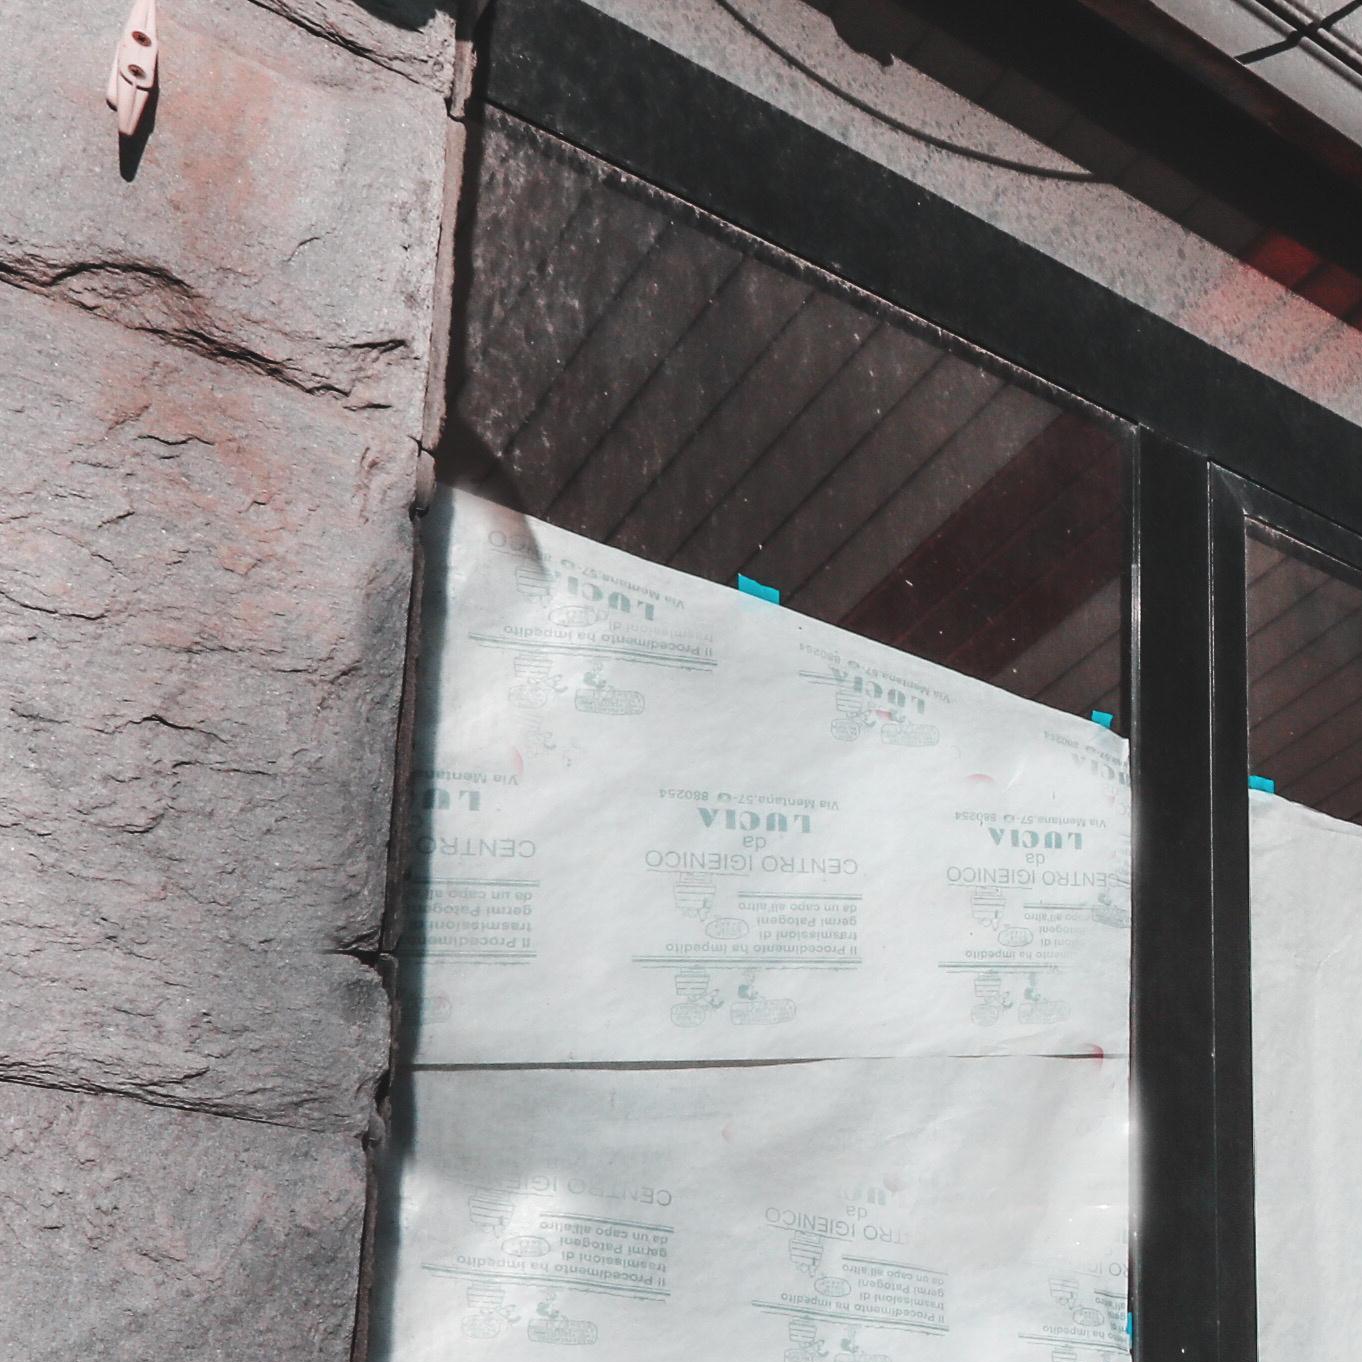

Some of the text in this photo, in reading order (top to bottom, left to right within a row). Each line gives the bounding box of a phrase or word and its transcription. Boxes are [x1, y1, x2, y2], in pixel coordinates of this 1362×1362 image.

[819, 799, 839, 811] Via
[697, 807, 811, 834] LUCIA
[1090, 818, 1106, 828] Via
[742, 836, 766, 852] da
[988, 827, 1082, 850] LUCIA
[645, 850, 858, 875] CENTRO IGIENICO
[1025, 853, 1045, 867] da
[946, 866, 1035, 884] IGIENICO
[824, 904, 839, 913] un
[842, 904, 856, 914] da
[820, 917, 856, 926] germi
[759, 931, 772, 940] di
[666, 941, 727, 953] impedito
[731, 944, 748, 954] ha
[753, 944, 846, 955] Procedimento
[965, 949, 1015, 959] impedito
[1019, 950, 1032, 959] ha
[846, 1205, 867, 1221] da
[764, 1207, 855, 1238] IGIENICO
[531, 1261, 549, 1273] ha
[836, 1303, 850, 1313] ha
[1093, 1331, 1104, 1339] ha
